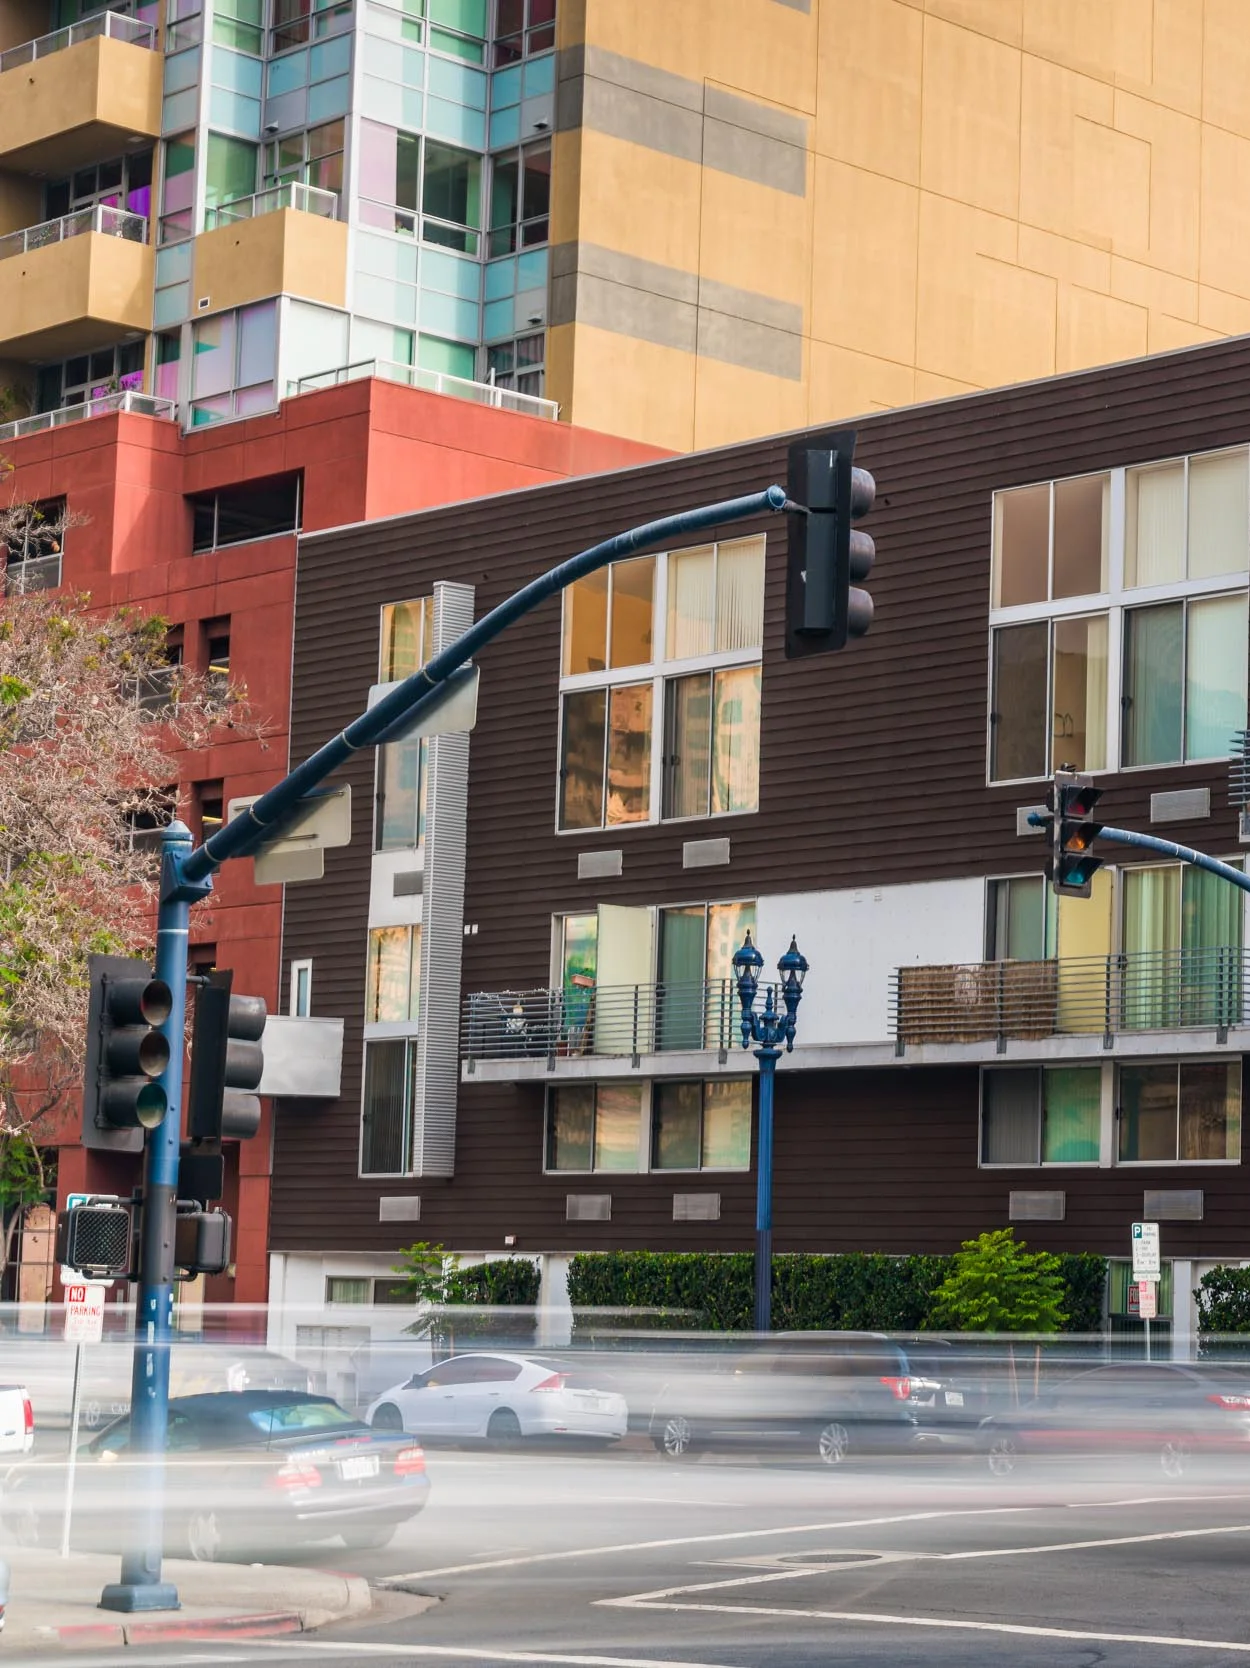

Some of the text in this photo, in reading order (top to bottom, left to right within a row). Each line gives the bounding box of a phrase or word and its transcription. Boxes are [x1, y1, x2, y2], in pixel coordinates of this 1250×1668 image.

[1134, 1226, 1141, 1238] P
[71, 1287, 84, 1301] NO
[70, 1305, 100, 1317] PARKING
